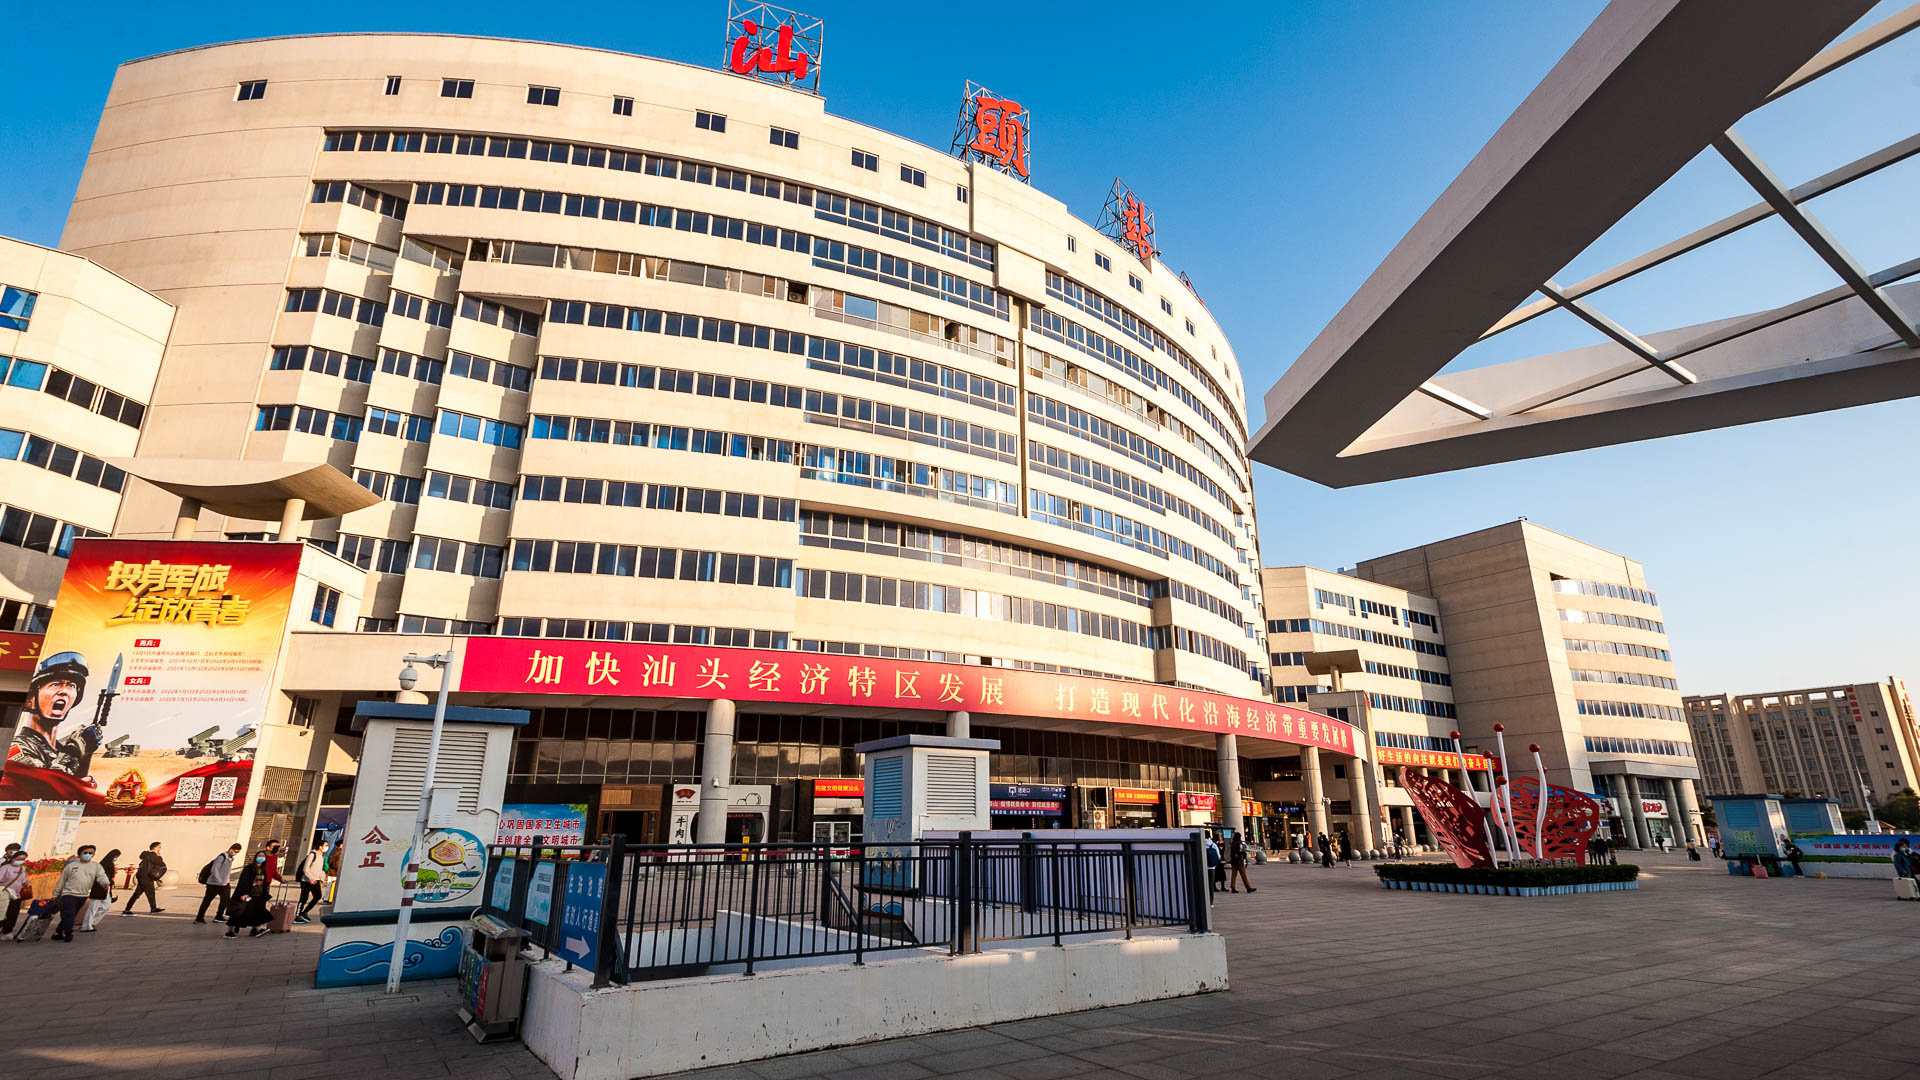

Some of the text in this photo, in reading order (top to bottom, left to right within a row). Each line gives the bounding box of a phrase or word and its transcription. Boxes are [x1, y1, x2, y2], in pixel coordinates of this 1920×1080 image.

[104, 560, 232, 597] 投身军旅
[525, 650, 1347, 748] 加快汕头经济特区发展 打造现代化沿海经济带重要发展极
[358, 825, 391, 868] 公正
[496, 835, 579, 846] 手创建全文明城市
